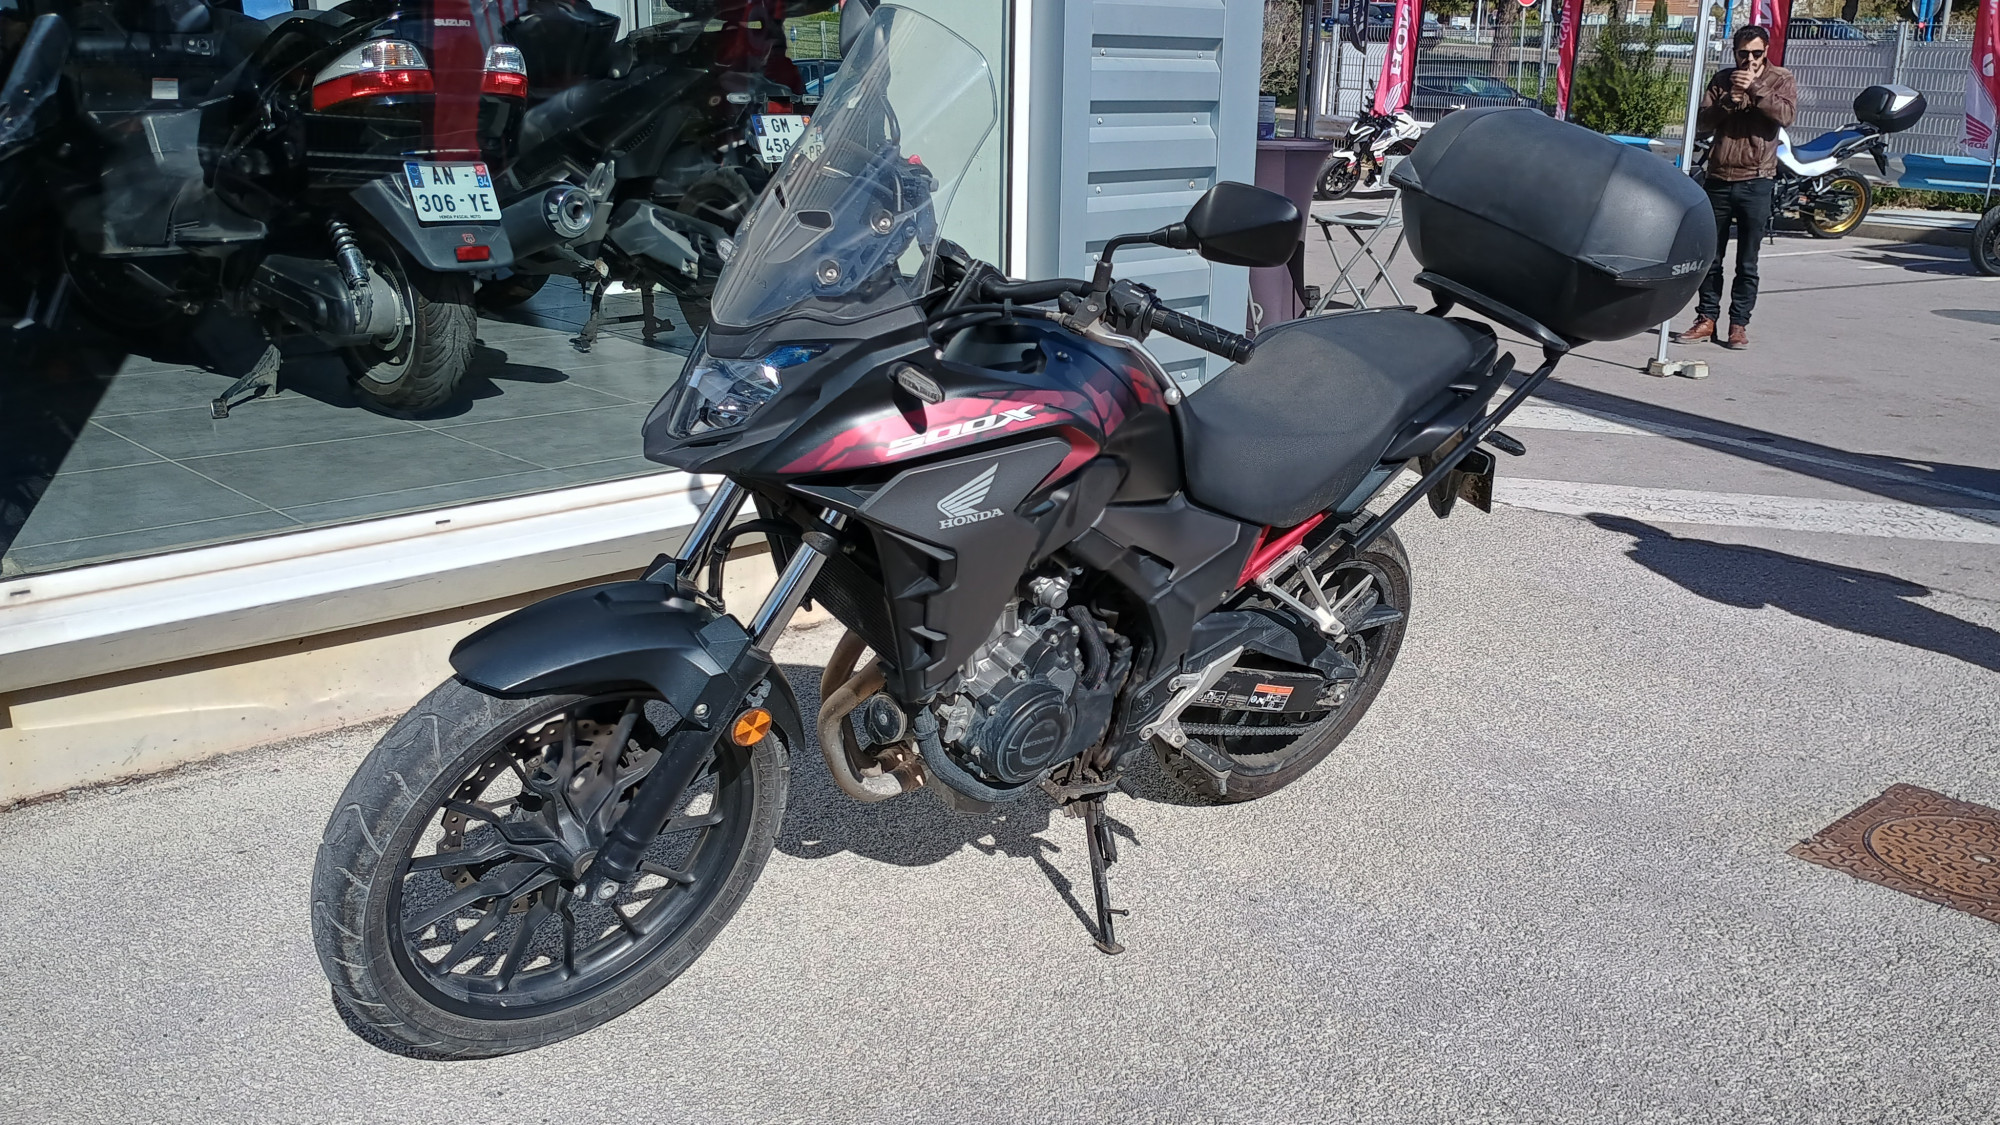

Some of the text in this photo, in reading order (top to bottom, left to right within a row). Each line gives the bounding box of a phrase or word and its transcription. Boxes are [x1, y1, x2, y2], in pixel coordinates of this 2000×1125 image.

[434, 19, 471, 27] SUZUKI
[419, 194, 493, 212] 306-YE
[886, 404, 1038, 457] 500X
[939, 508, 1004, 530] HONDA
